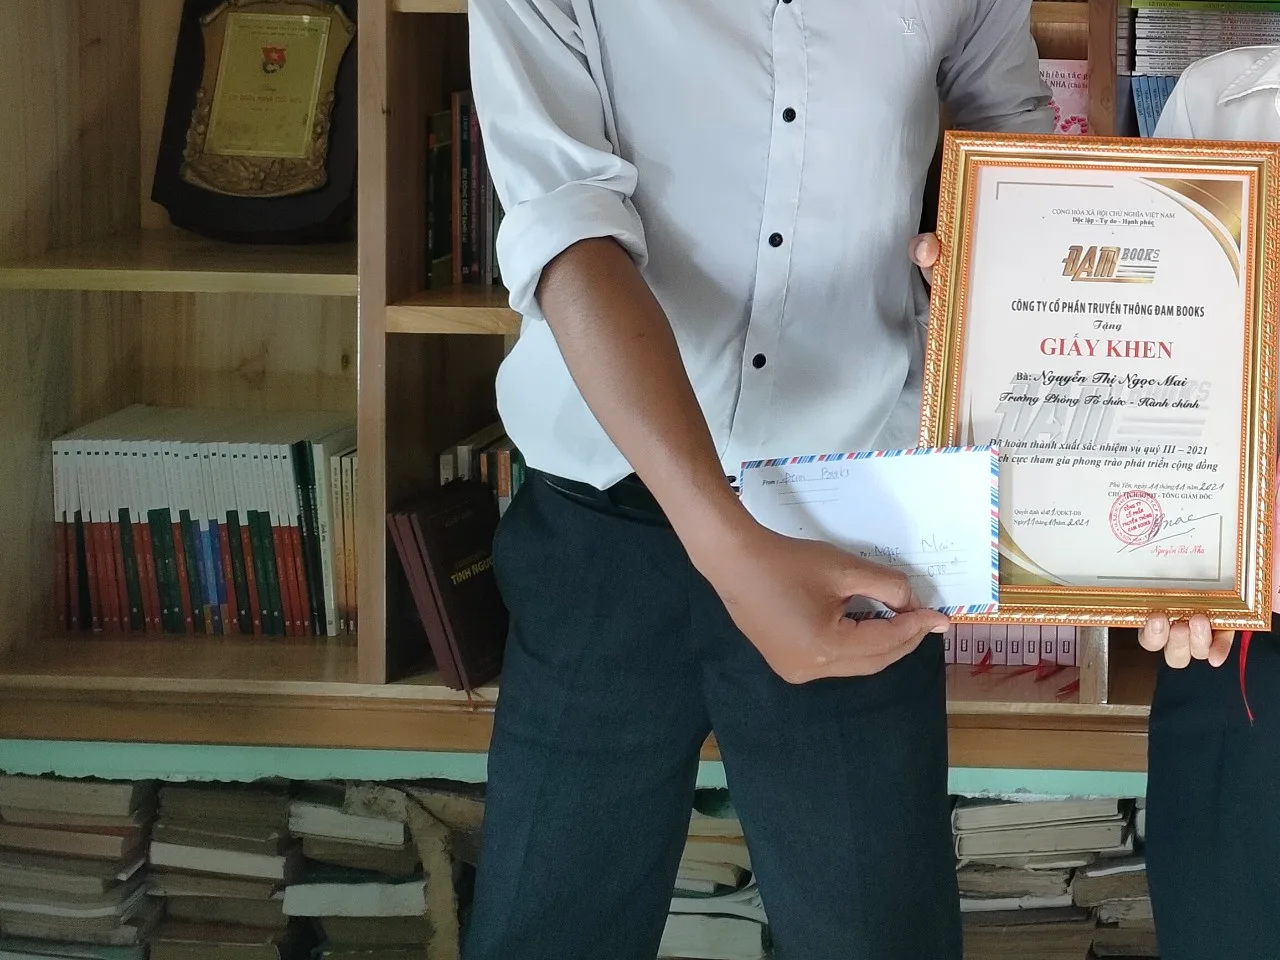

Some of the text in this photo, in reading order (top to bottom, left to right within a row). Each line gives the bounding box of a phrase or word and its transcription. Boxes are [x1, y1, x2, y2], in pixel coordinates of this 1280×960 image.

[1145, 211, 1160, 219] VIỆT
[1121, 247, 1160, 262] BOOKS
[1011, 298, 1035, 311] CÔNG
[1037, 301, 1048, 312] TY
[1123, 302, 1153, 315] THÔNG
[1155, 305, 1174, 316] ĐAM
[1176, 305, 1205, 317] BOOKS
[1093, 319, 1122, 331] Tặng
[1040, 333, 1174, 359] GIẤY KHEN
[1016, 370, 1188, 389] Bà: Nguyễn Thị Ngọc Mai
[999, 392, 1201, 409] Trưởng Phòng Tổ chức Hành chính
[1004, 439, 1027, 449] hoàn
[1030, 440, 1057, 450] thành
[1058, 438, 1080, 450] xuất
[1082, 439, 1097, 451] sắc
[1100, 442, 1127, 454] nhiệm
[1131, 446, 1141, 454] vụ
[1143, 445, 1160, 455] quý
[1162, 444, 1176, 454] III
[1186, 445, 1208, 455] 2021
[1011, 456, 1028, 465] cực
[1030, 456, 1054, 464] tham
[1056, 456, 1070, 466] gia
[1072, 456, 1101, 468] phong
[1104, 458, 1122, 467] trào
[1124, 459, 1145, 469] phát
[1147, 457, 1169, 468] triển
[1171, 460, 1193, 471] cộng
[1196, 459, 1218, 472] đồng
[1199, 482, 1225, 491] 2021
[1181, 492, 1198, 500] GIÁM
[1151, 545, 1176, 557] Nguyễn
